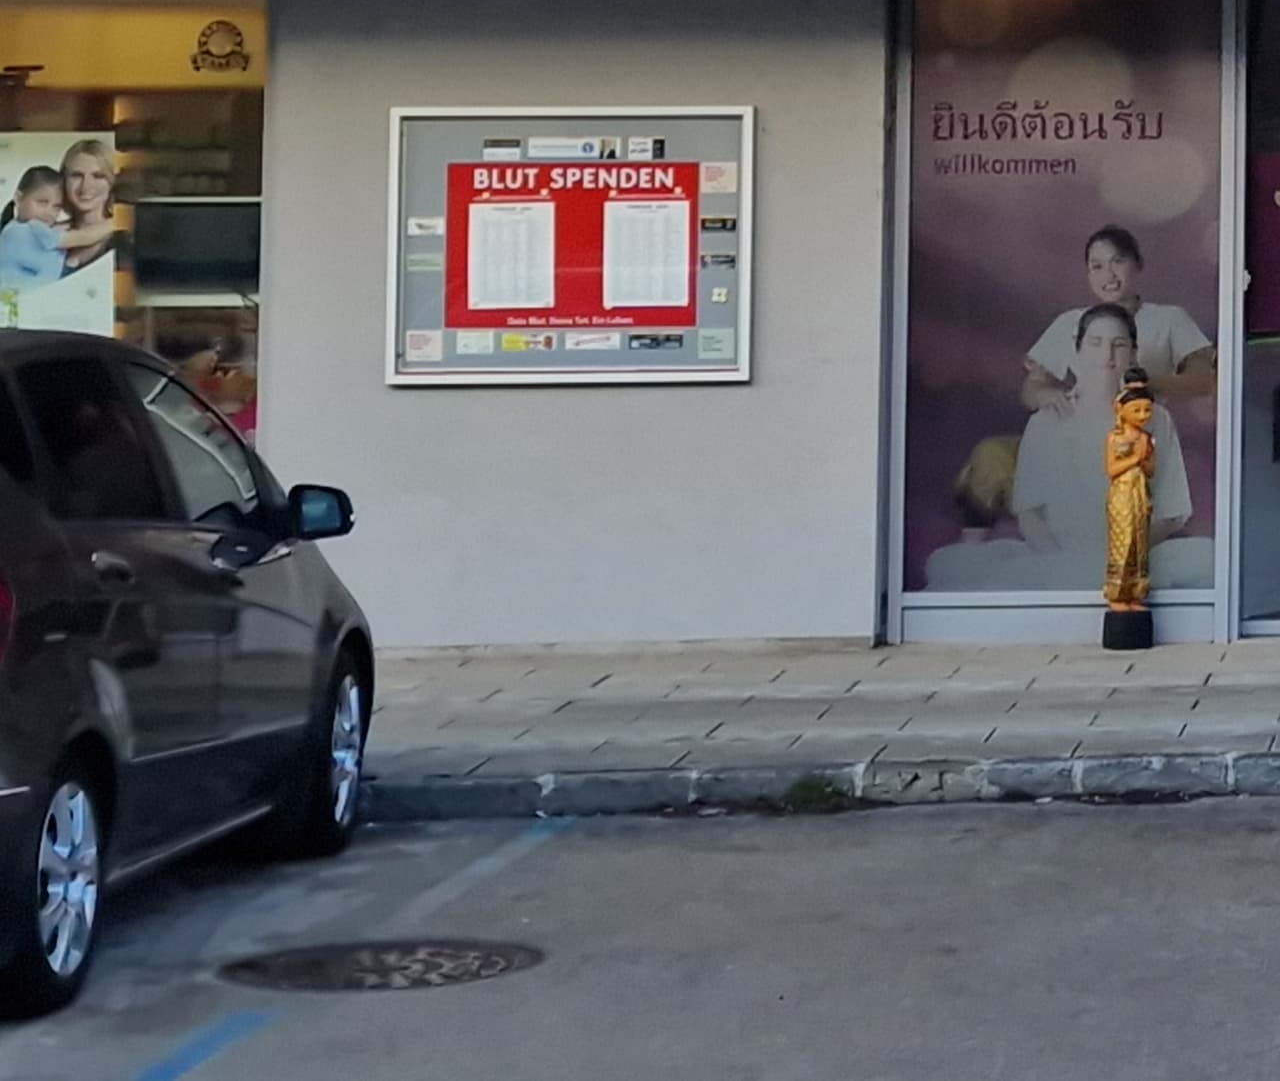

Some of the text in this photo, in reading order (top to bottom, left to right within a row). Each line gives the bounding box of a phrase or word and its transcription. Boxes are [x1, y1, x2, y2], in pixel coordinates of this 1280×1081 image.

[932, 99, 1164, 141] ยินดีต้อนรับ
[934, 154, 1077, 175] willkommen
[473, 167, 675, 190] BLUT SPENDEN
